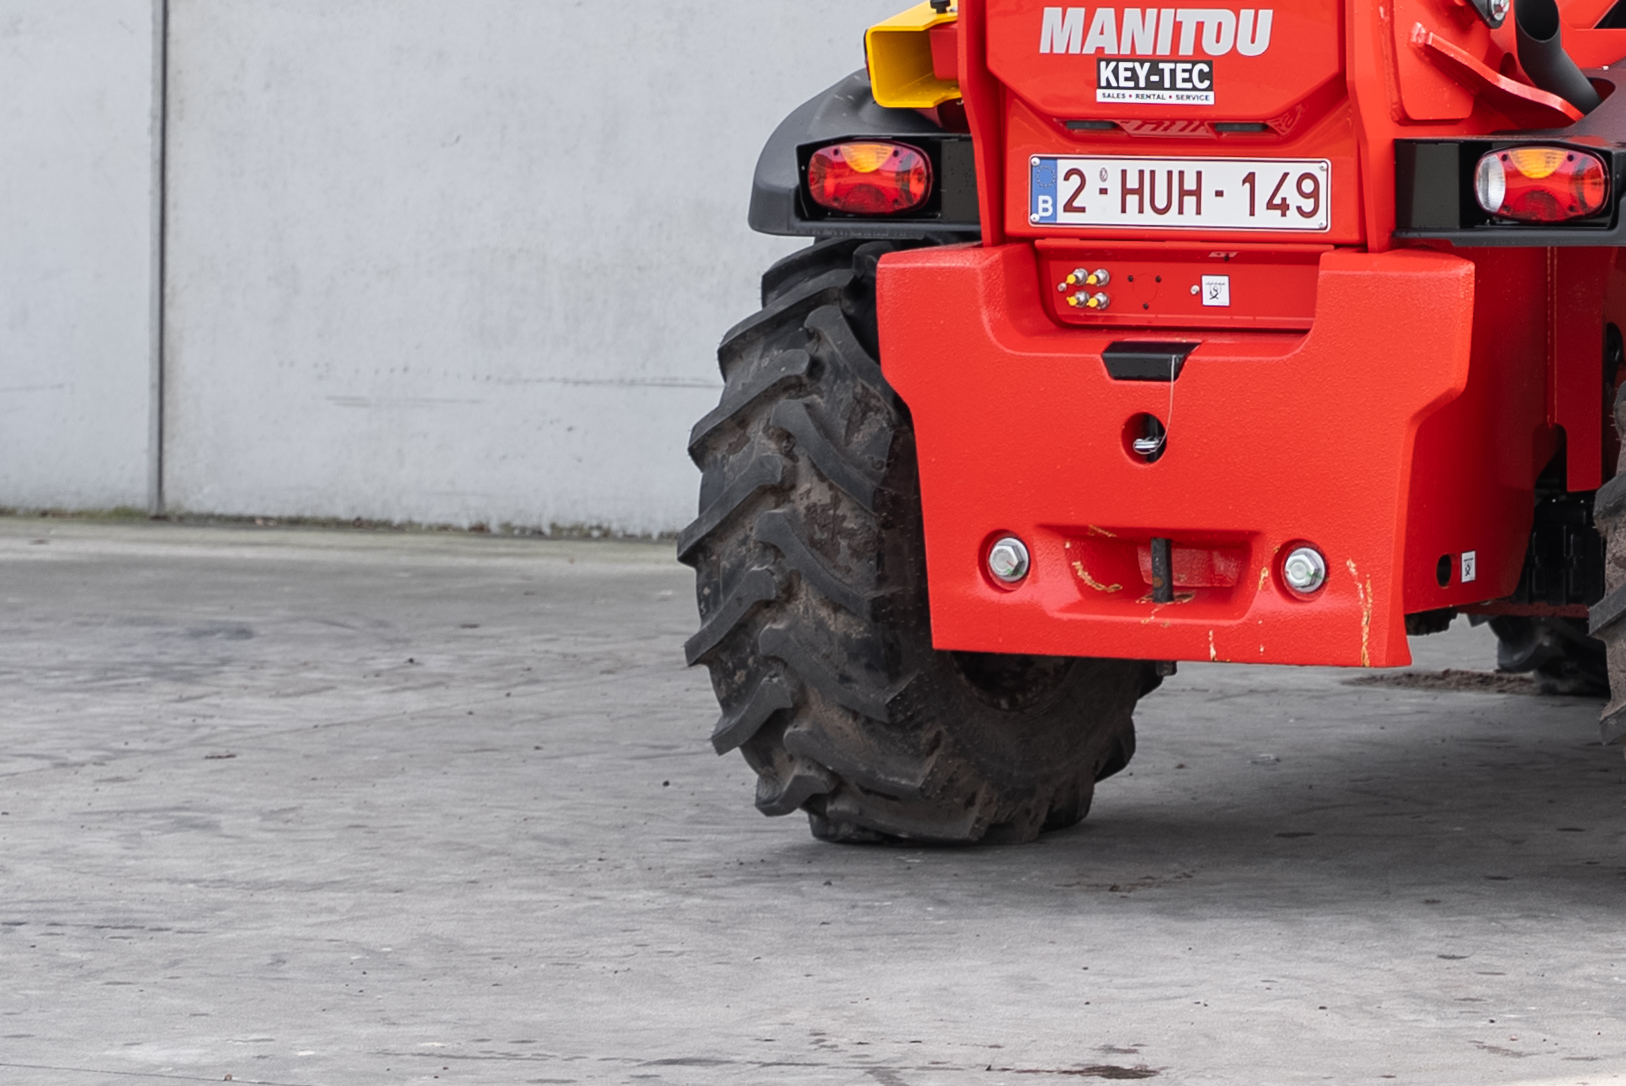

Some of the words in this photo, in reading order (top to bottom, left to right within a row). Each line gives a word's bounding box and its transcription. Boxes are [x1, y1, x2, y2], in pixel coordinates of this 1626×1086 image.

[1039, 7, 1273, 56] MANITOU
[1100, 61, 1210, 89] KEY-TEC
[1038, 195, 1053, 217] B
